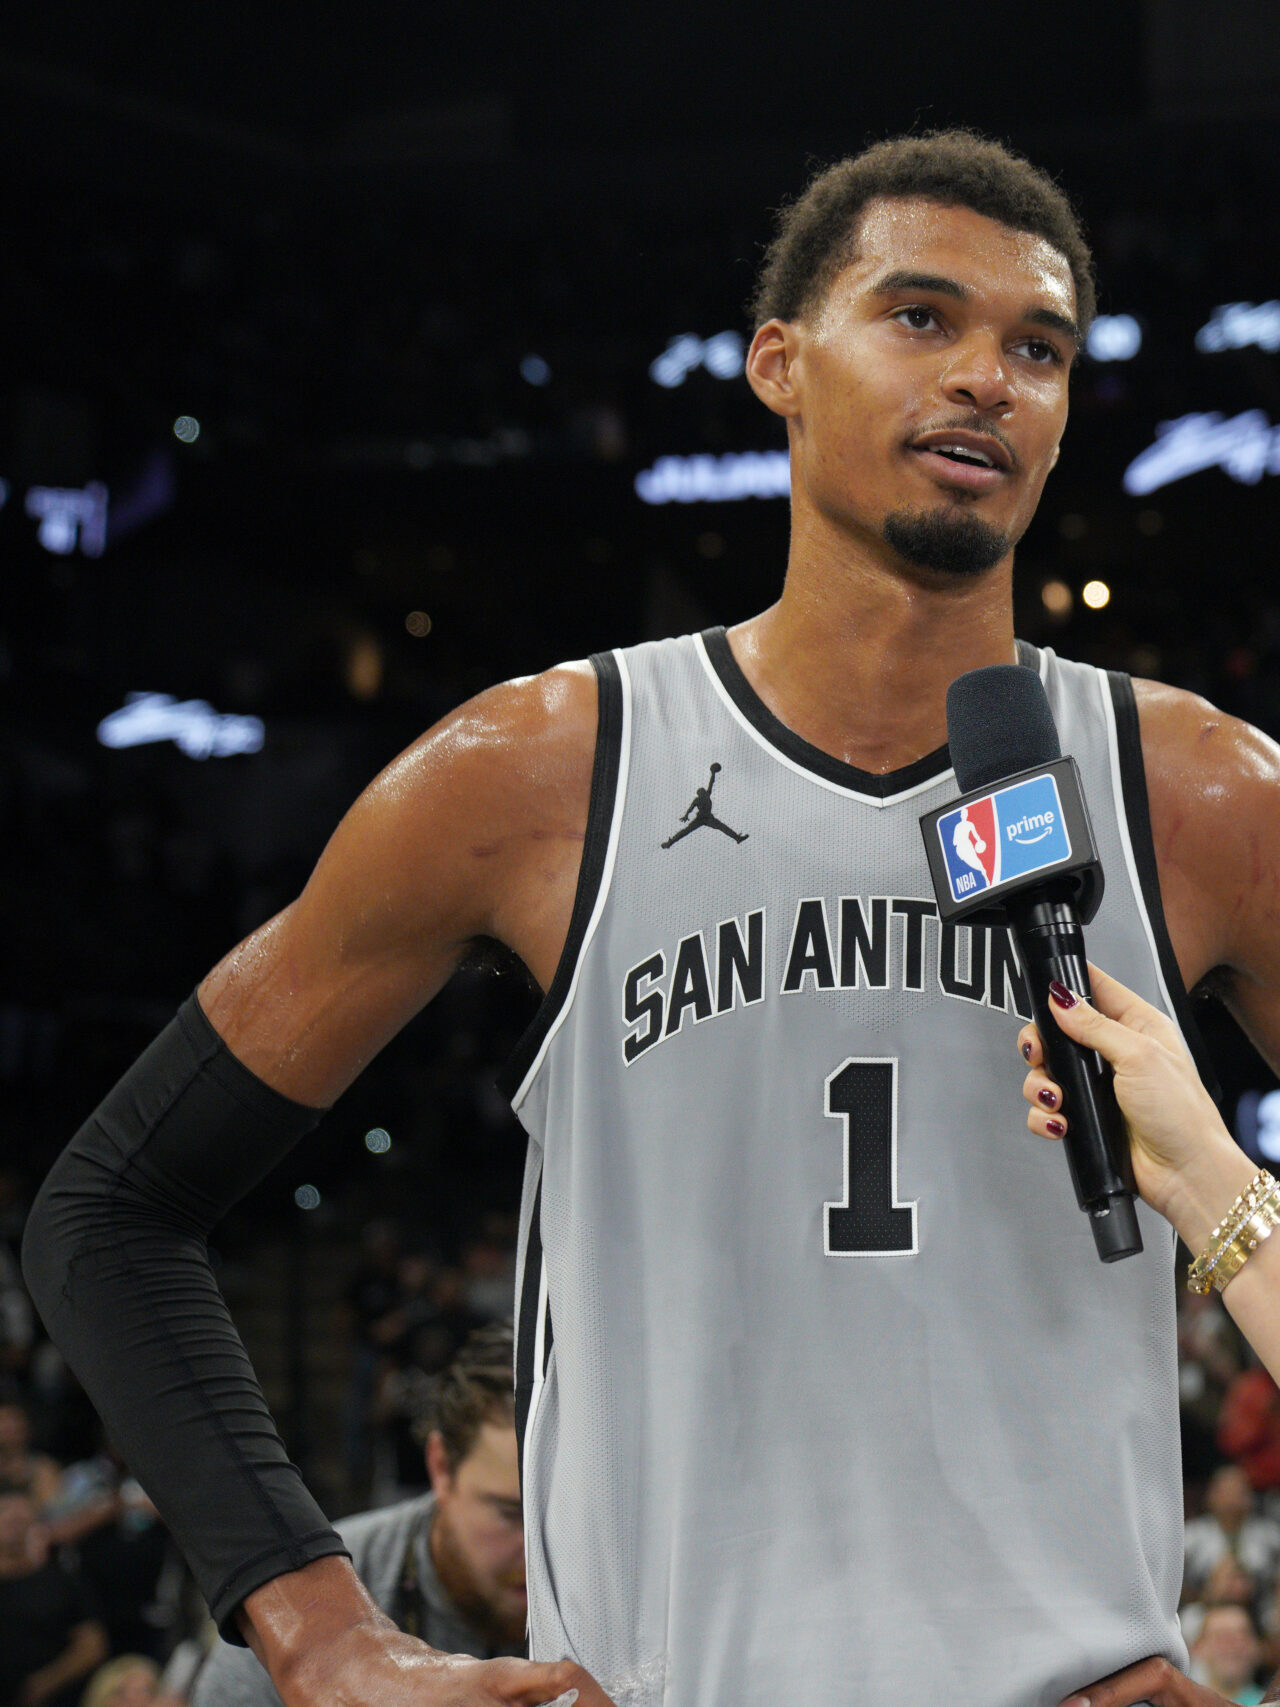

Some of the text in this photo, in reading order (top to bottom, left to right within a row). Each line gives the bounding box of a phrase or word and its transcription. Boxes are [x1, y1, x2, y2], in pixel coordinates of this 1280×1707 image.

[1006, 811, 1055, 841] prime
[956, 872, 977, 895] NBA
[622, 896, 1035, 1068] SAN ANTON
[824, 1057, 919, 1257] 1
